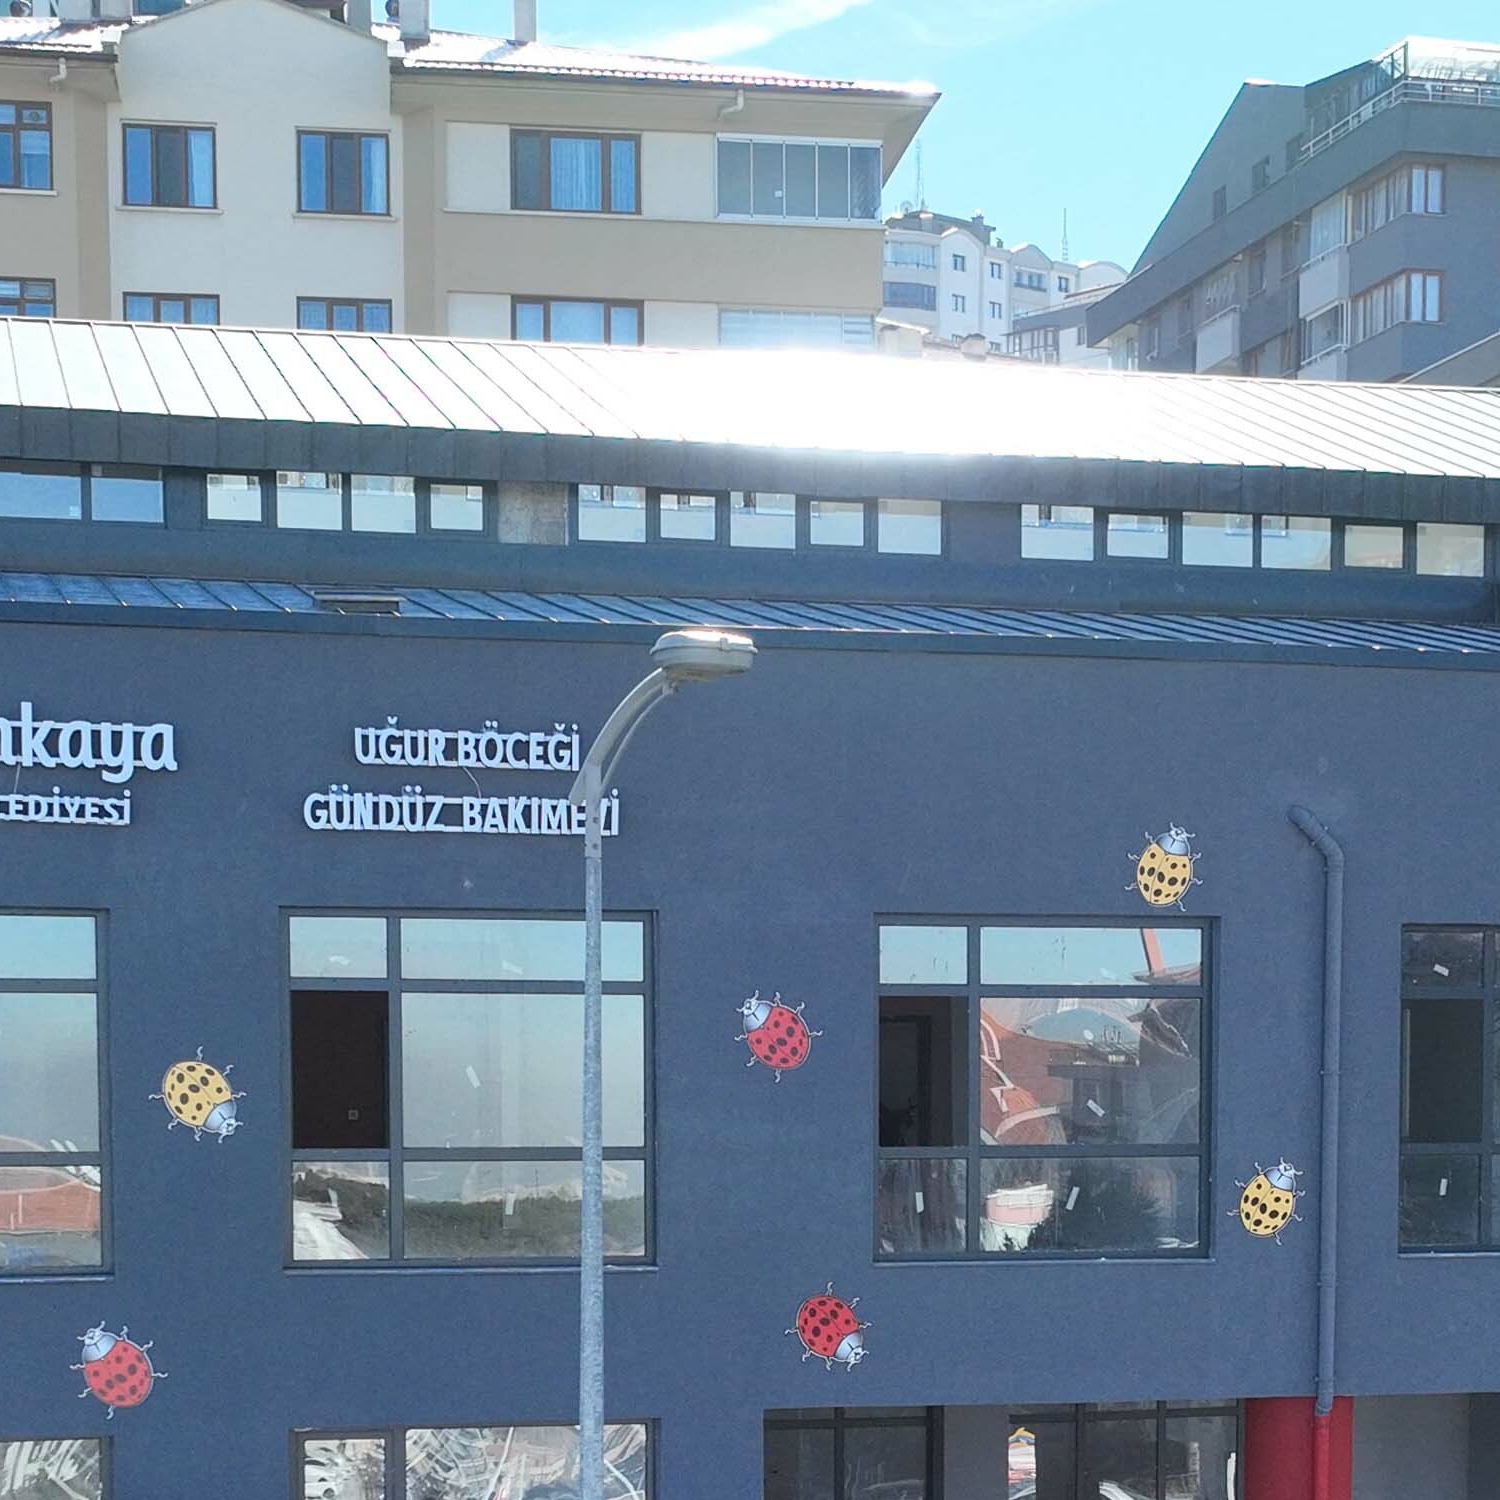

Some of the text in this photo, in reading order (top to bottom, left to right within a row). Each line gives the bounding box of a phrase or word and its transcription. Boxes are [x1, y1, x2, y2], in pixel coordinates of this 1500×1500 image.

[354, 715, 580, 771] UĞUR BÖCEĞİ
[303, 783, 447, 834] GÜNDÜZ
